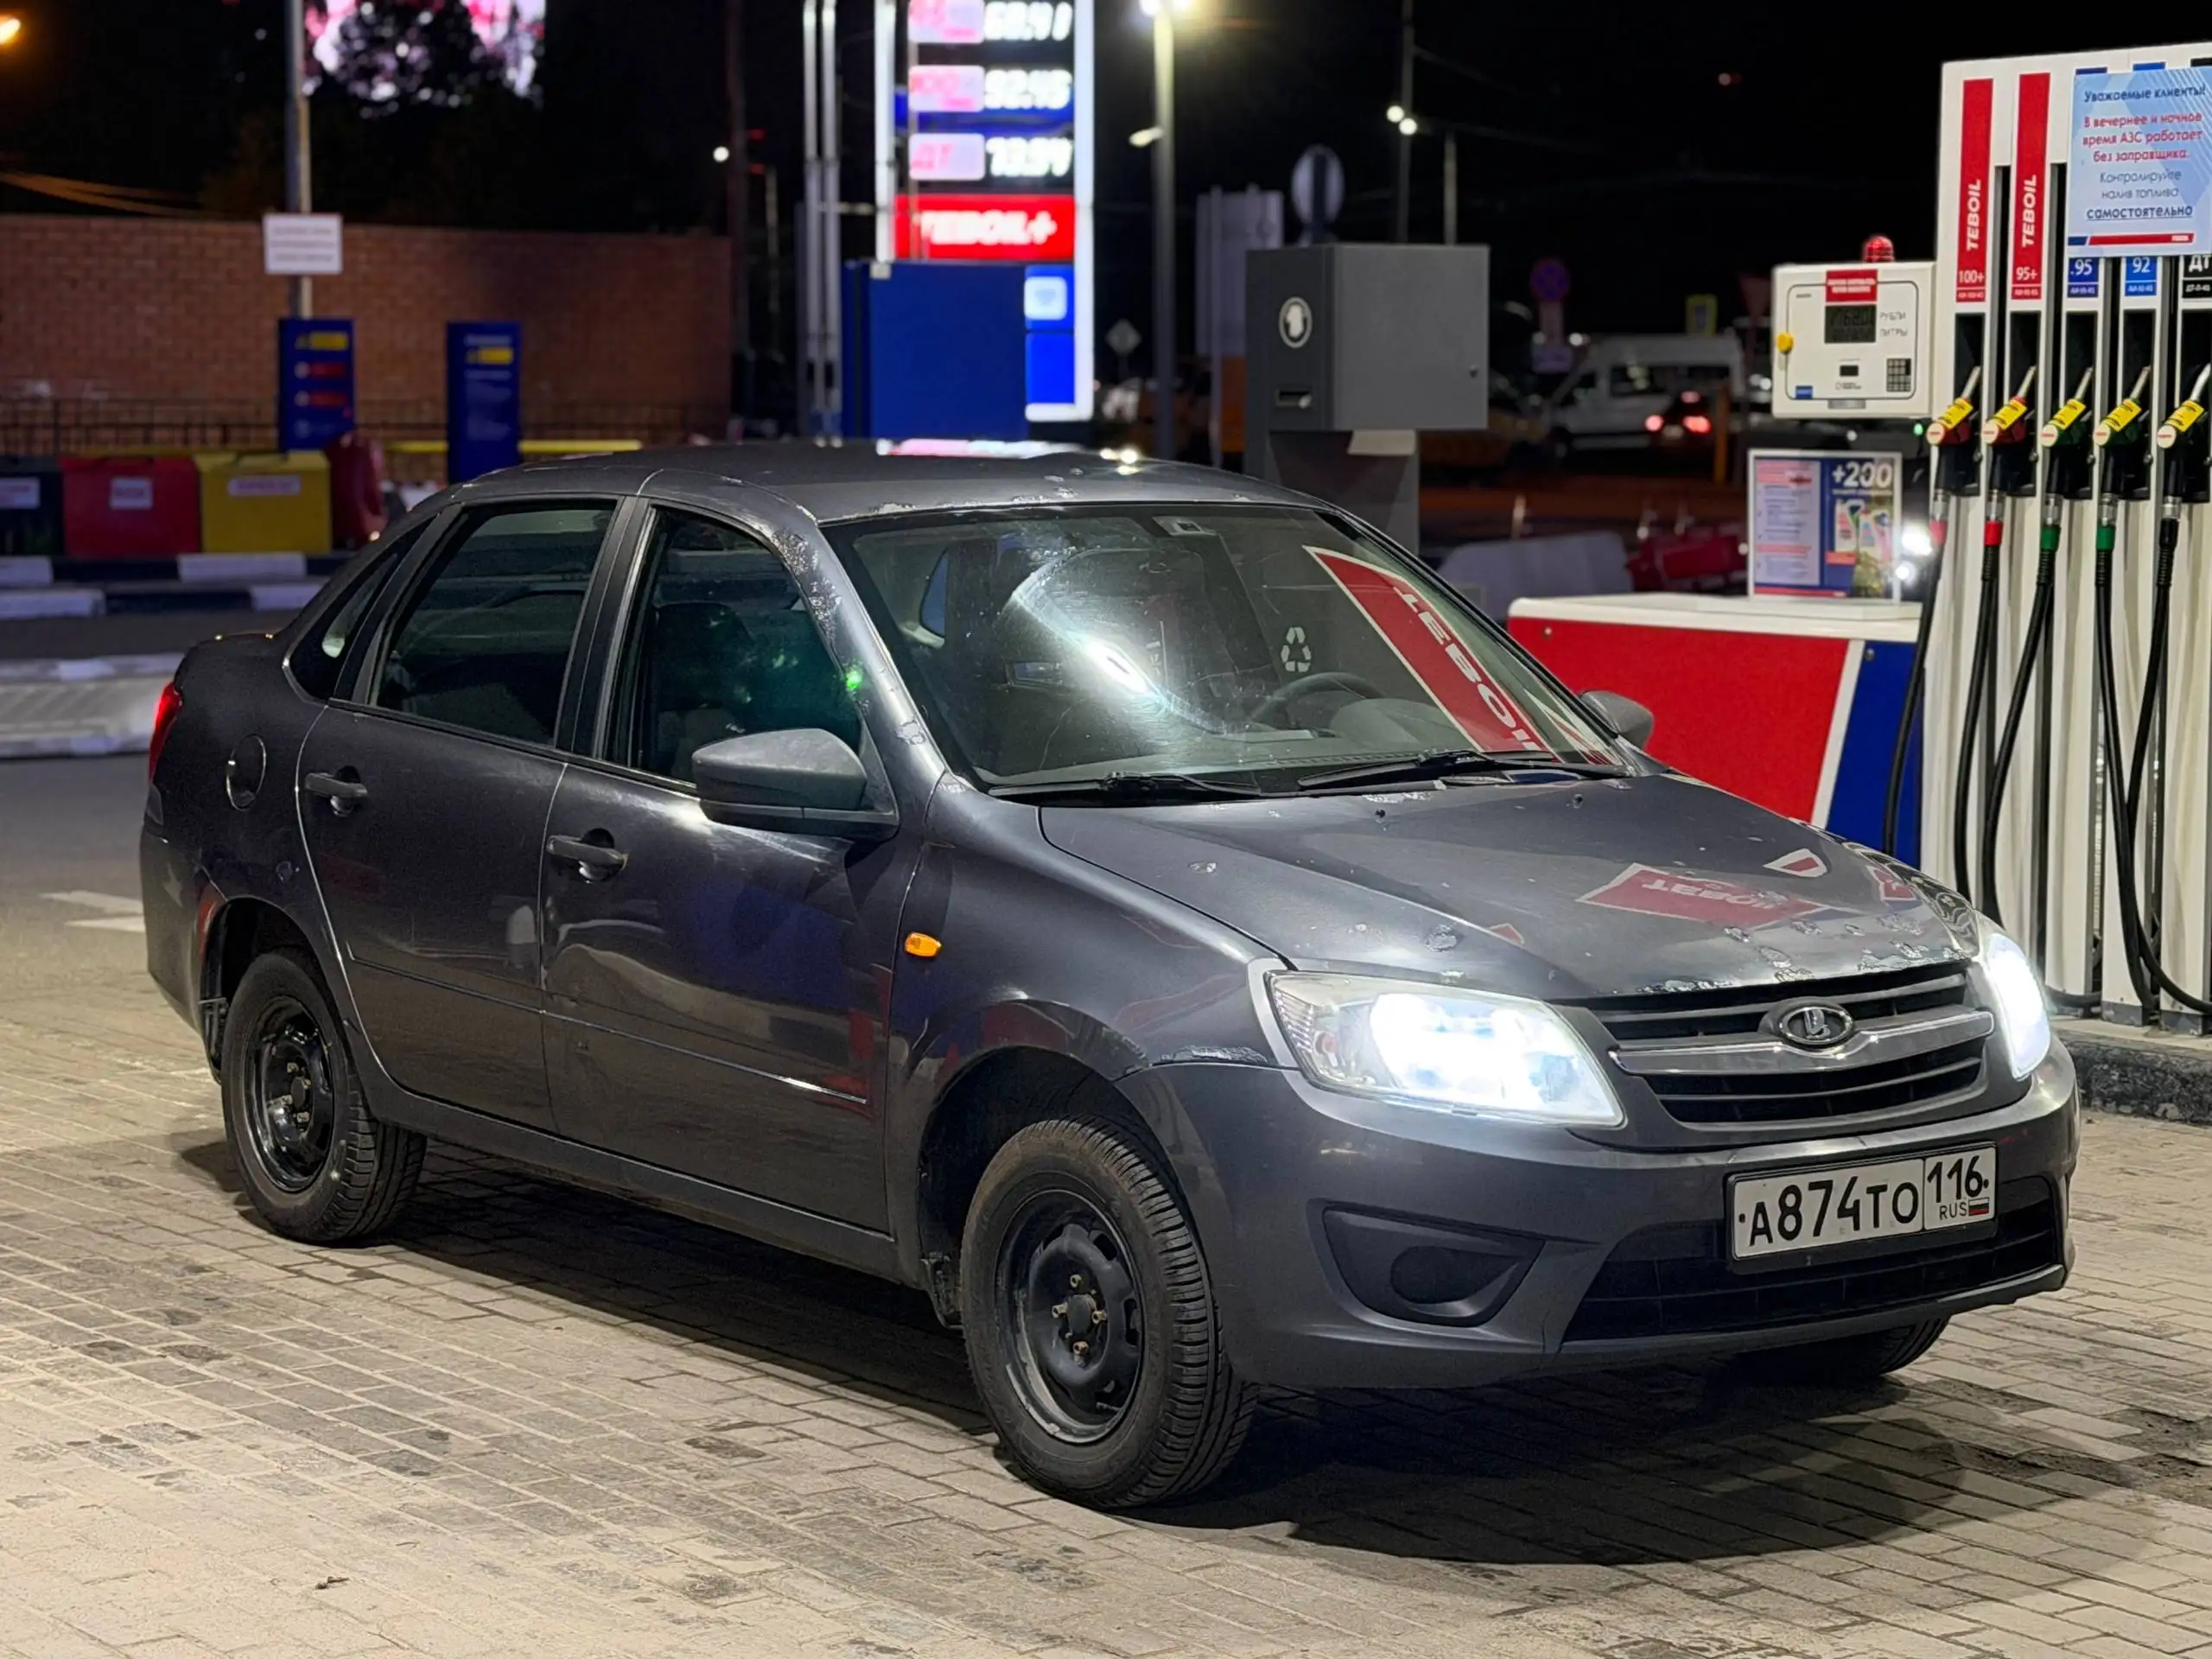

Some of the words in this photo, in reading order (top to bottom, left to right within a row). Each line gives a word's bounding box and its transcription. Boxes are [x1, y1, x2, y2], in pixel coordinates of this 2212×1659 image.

[2084, 90, 2152, 102] Уважаемые
[2154, 83, 2207, 99] клиенты!
[2084, 116, 2090, 128] В
[2093, 116, 2148, 129] вечернее
[2151, 115, 2158, 124] и
[2161, 112, 2202, 124] ночное
[2082, 134, 2117, 148] время
[2120, 130, 2143, 143] АЗС
[2145, 129, 2203, 146] работает
[2093, 149, 2113, 162] без
[2100, 168, 2183, 184] Контролируйте
[2101, 188, 2133, 200] налив
[2136, 188, 2179, 199] топлива
[1967, 179, 1981, 251] TEBOIL
[2022, 175, 2037, 248] TEBOIL
[2087, 205, 2193, 219] самостоятельно
[2016, 266, 2038, 281] 95+
[2132, 257, 2151, 274] 92
[1959, 270, 1985, 283] 100+
[1748, 1175, 1919, 1247] А874ТО
[1927, 1155, 1984, 1204] 116
[1939, 1200, 1968, 1221] RUS
